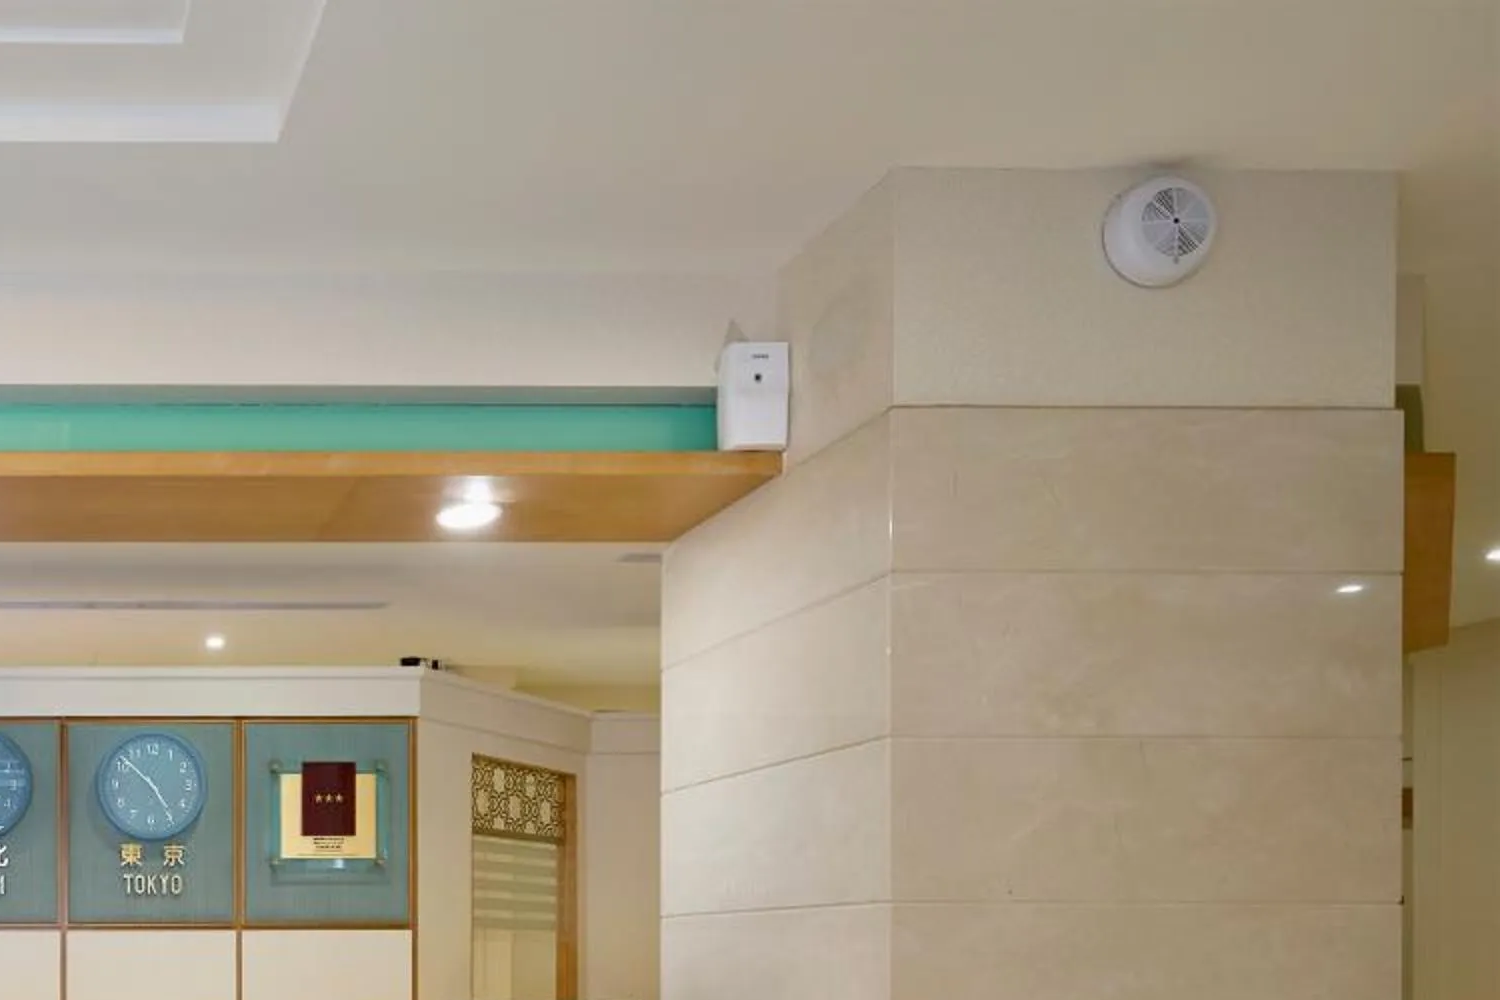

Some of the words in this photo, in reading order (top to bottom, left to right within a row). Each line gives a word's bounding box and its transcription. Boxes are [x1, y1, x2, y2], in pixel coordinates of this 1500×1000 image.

[146, 743, 159, 755] 12
[120, 843, 185, 867] 東京
[123, 875, 182, 895] TOKYO
